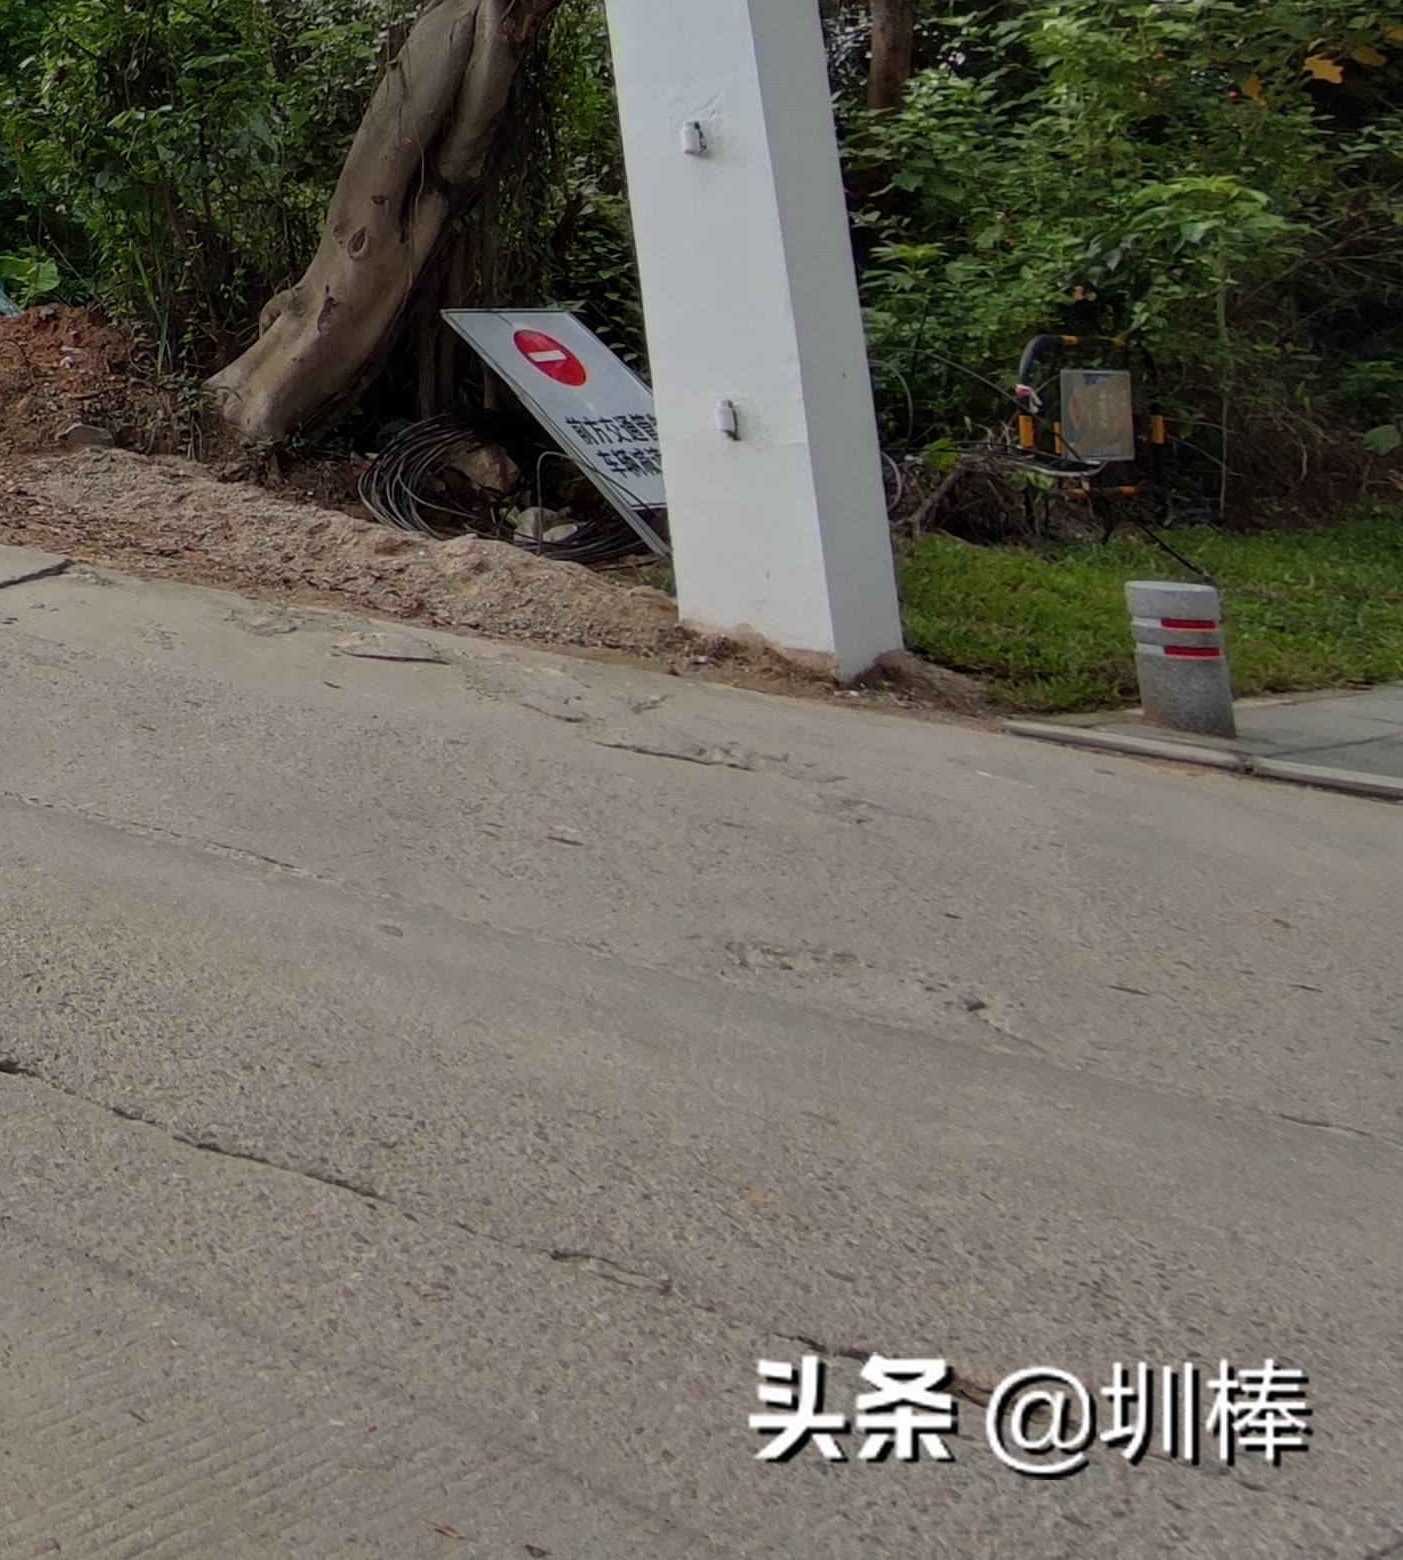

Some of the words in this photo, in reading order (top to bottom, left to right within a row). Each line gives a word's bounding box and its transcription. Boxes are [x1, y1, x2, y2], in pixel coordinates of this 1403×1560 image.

[566, 414, 658, 445] 前方交通管
